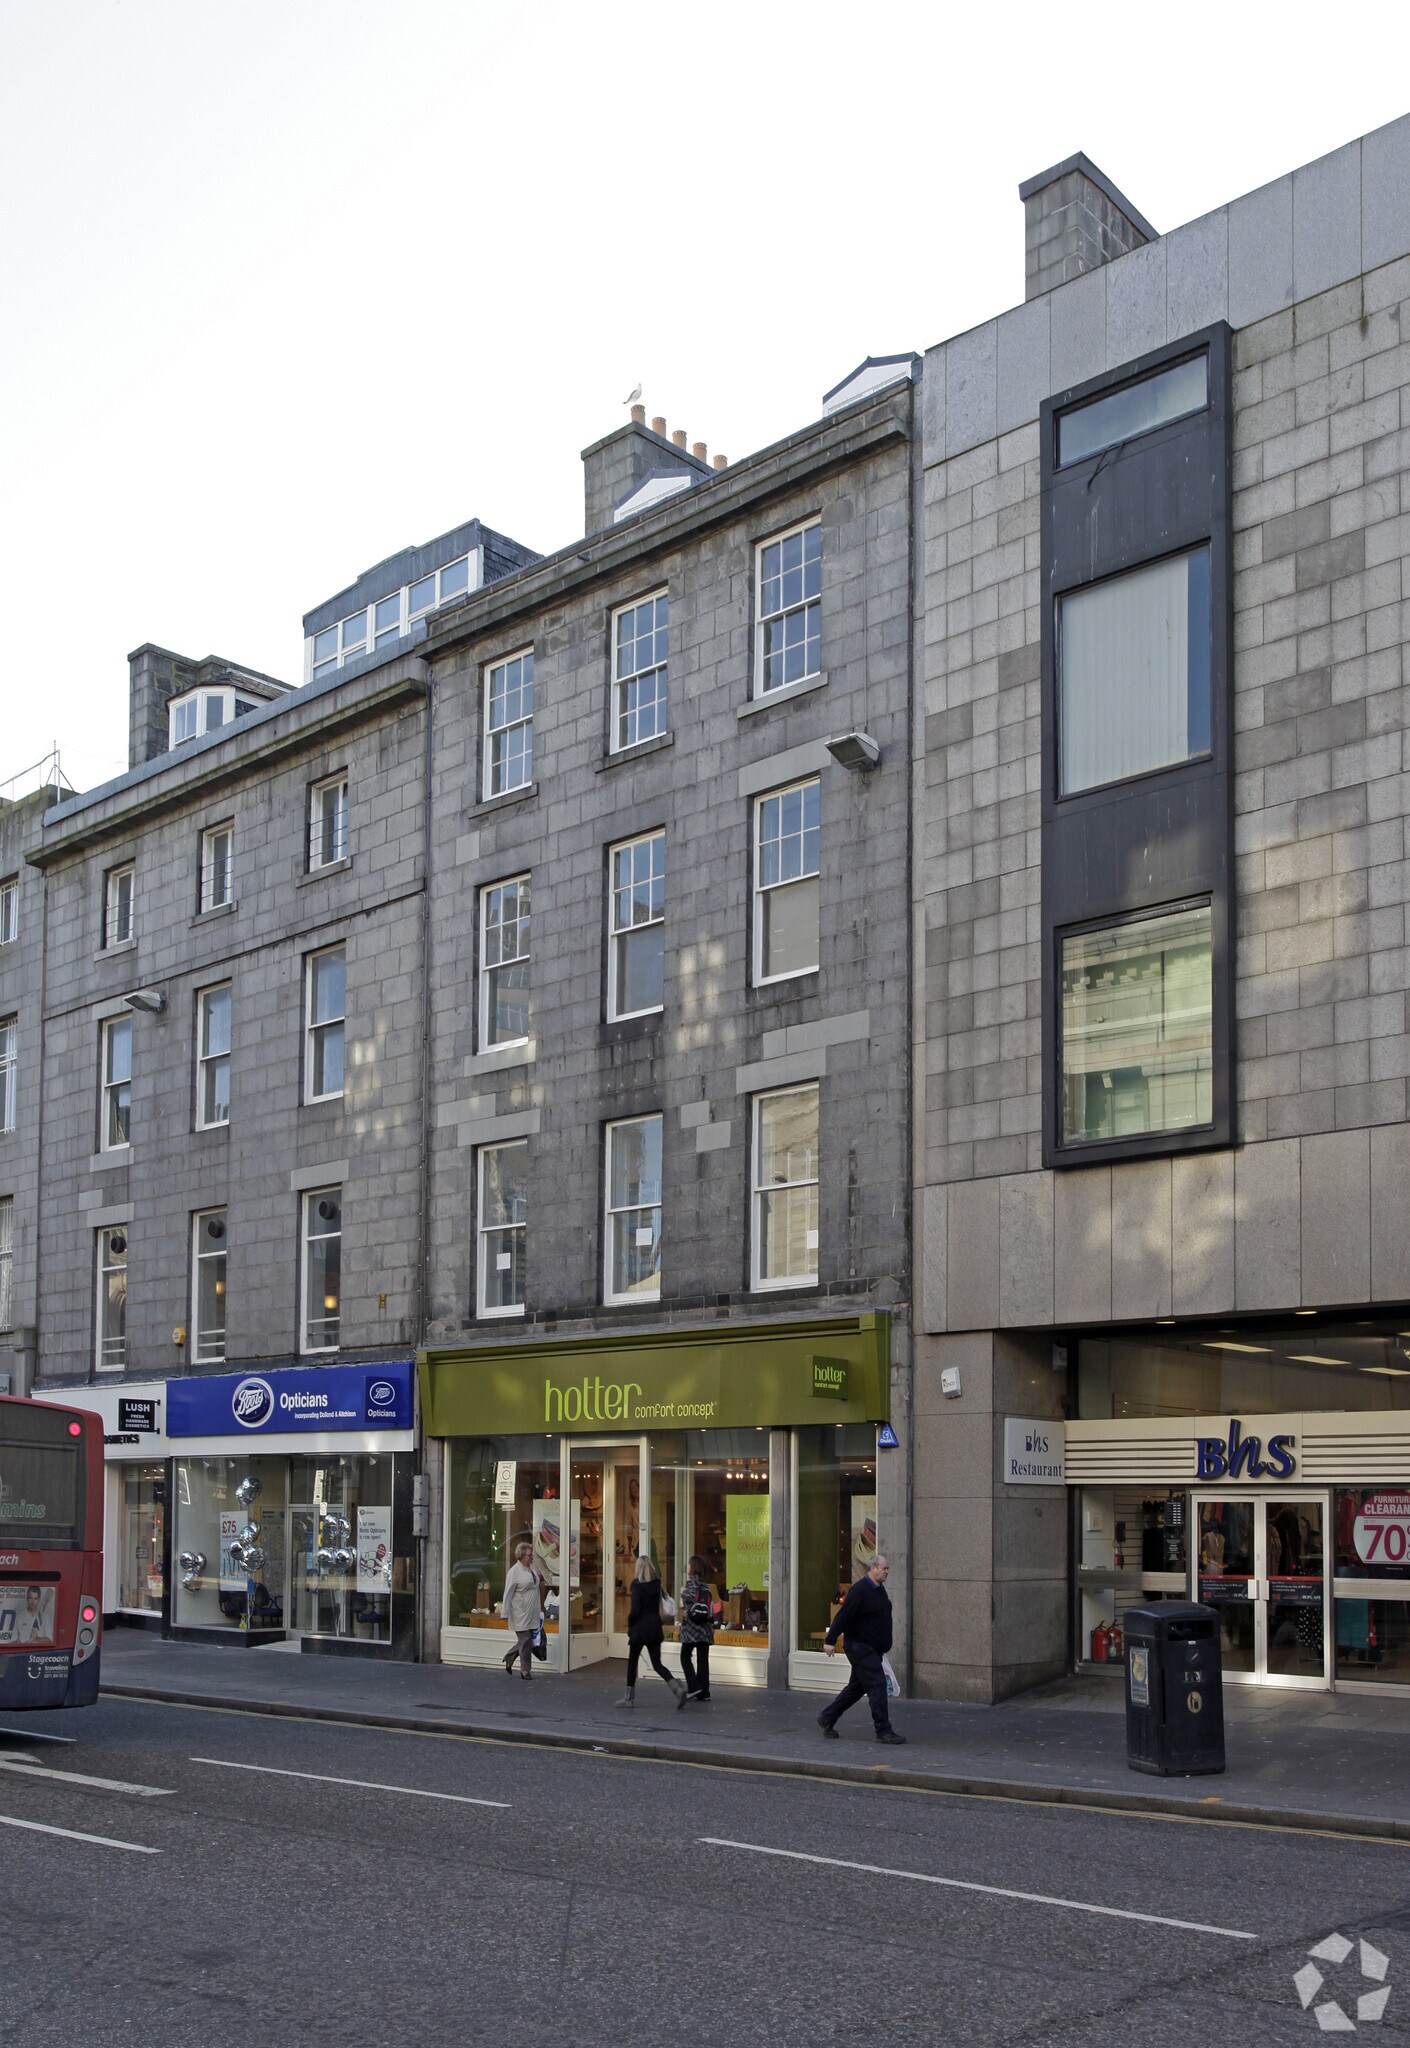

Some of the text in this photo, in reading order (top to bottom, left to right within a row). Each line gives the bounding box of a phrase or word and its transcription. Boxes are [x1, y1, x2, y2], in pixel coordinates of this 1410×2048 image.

[815, 1365, 846, 1383] hotter
[236, 1388, 264, 1415] Boots
[280, 1391, 329, 1411] Opticians
[545, 1376, 642, 1421] hotter
[125, 1403, 151, 1412] LUSH
[367, 1408, 397, 1418] Opticians
[635, 1403, 715, 1420] comfort concept
[1011, 1459, 1062, 1477] Restaurant
[1373, 1495, 1410, 1504] FURNITUR
[0, 1499, 46, 1518] mins
[222, 1520, 237, 1534] £75
[28, 1654, 70, 1665] Stagecoach
